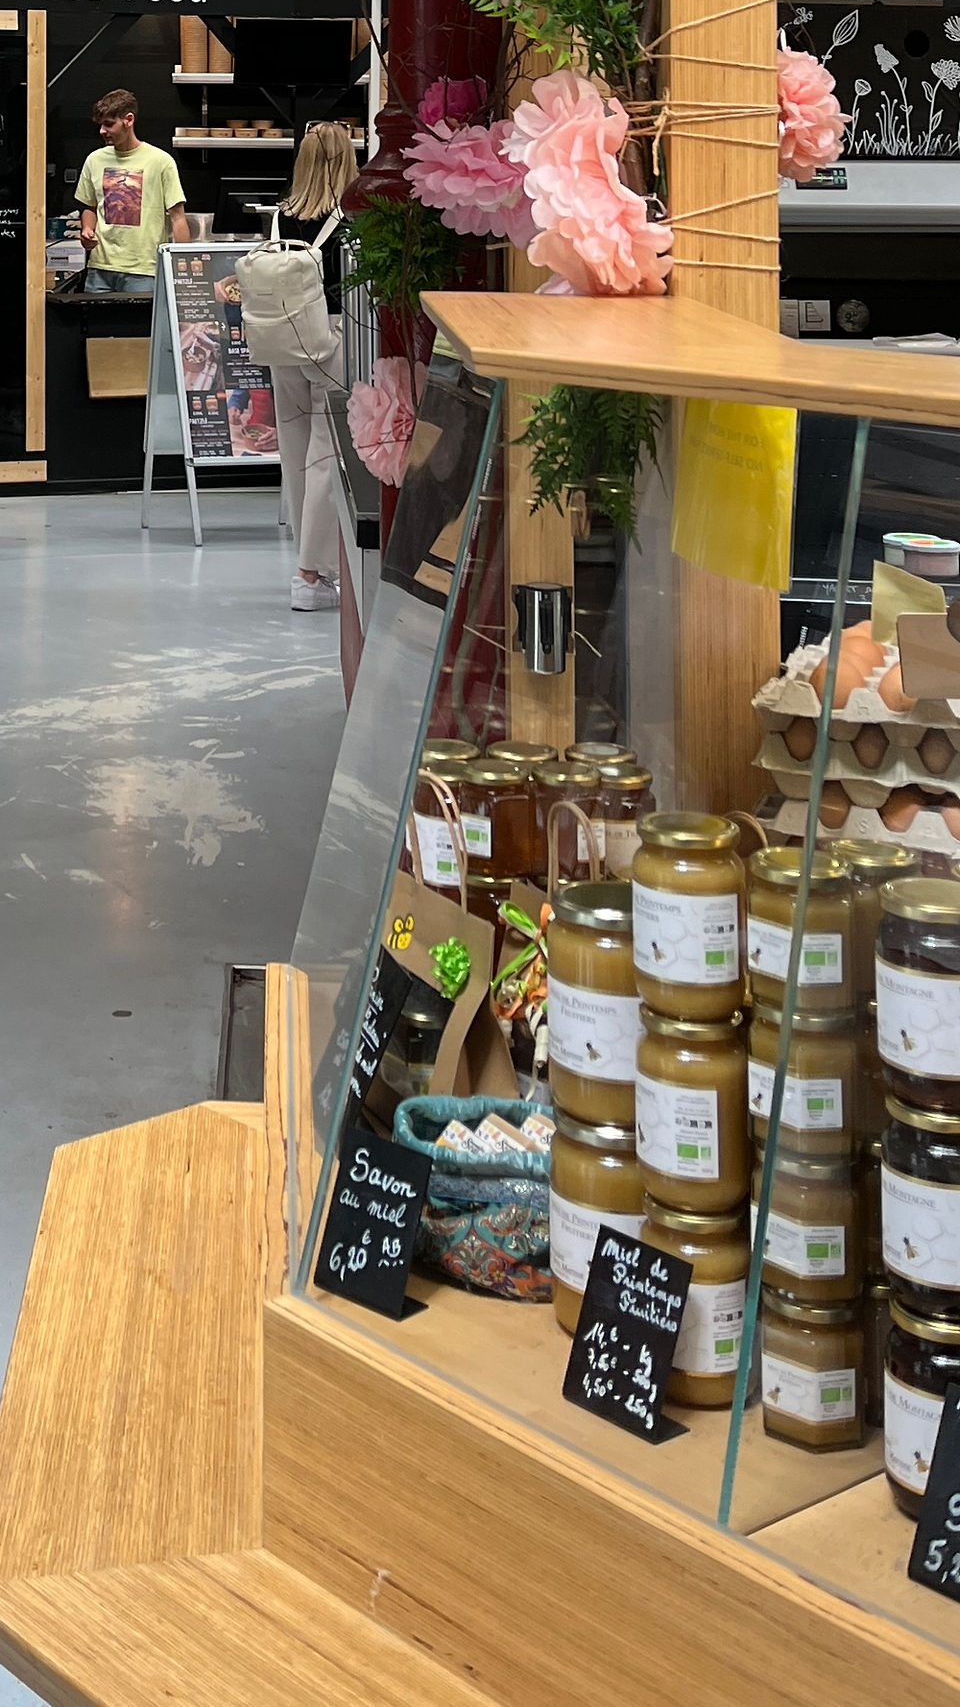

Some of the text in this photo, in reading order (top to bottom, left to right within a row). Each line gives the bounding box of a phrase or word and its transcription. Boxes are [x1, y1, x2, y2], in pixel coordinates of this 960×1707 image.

[350, 1147, 417, 1198] Savon
[340, 1188, 407, 1229] au miel
[381, 1235, 401, 1259] AB
[601, 1237, 640, 1268] Miel
[650, 1257, 669, 1283] de
